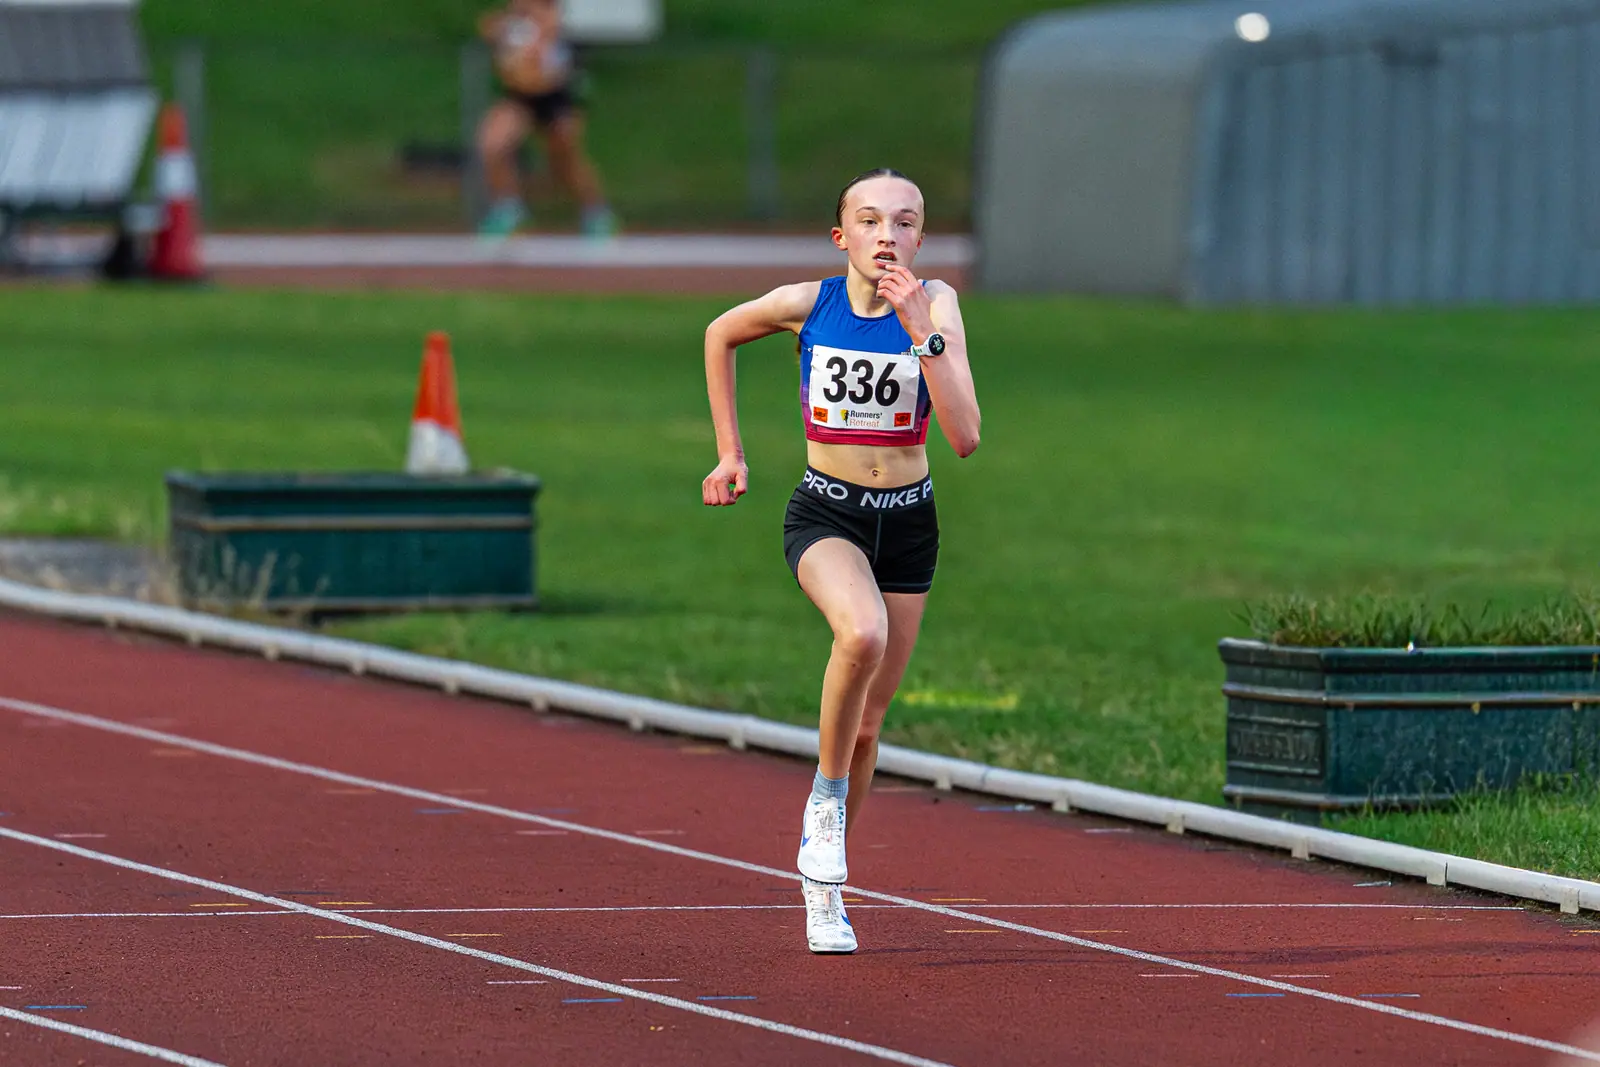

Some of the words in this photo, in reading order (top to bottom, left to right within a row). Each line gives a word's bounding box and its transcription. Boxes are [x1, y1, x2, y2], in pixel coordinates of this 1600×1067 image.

[823, 356, 900, 407] 336
[850, 410, 882, 419] Runners'
[850, 418, 880, 428] Retreat
[802, 470, 849, 500] PRO
[860, 487, 920, 509] NIKE
